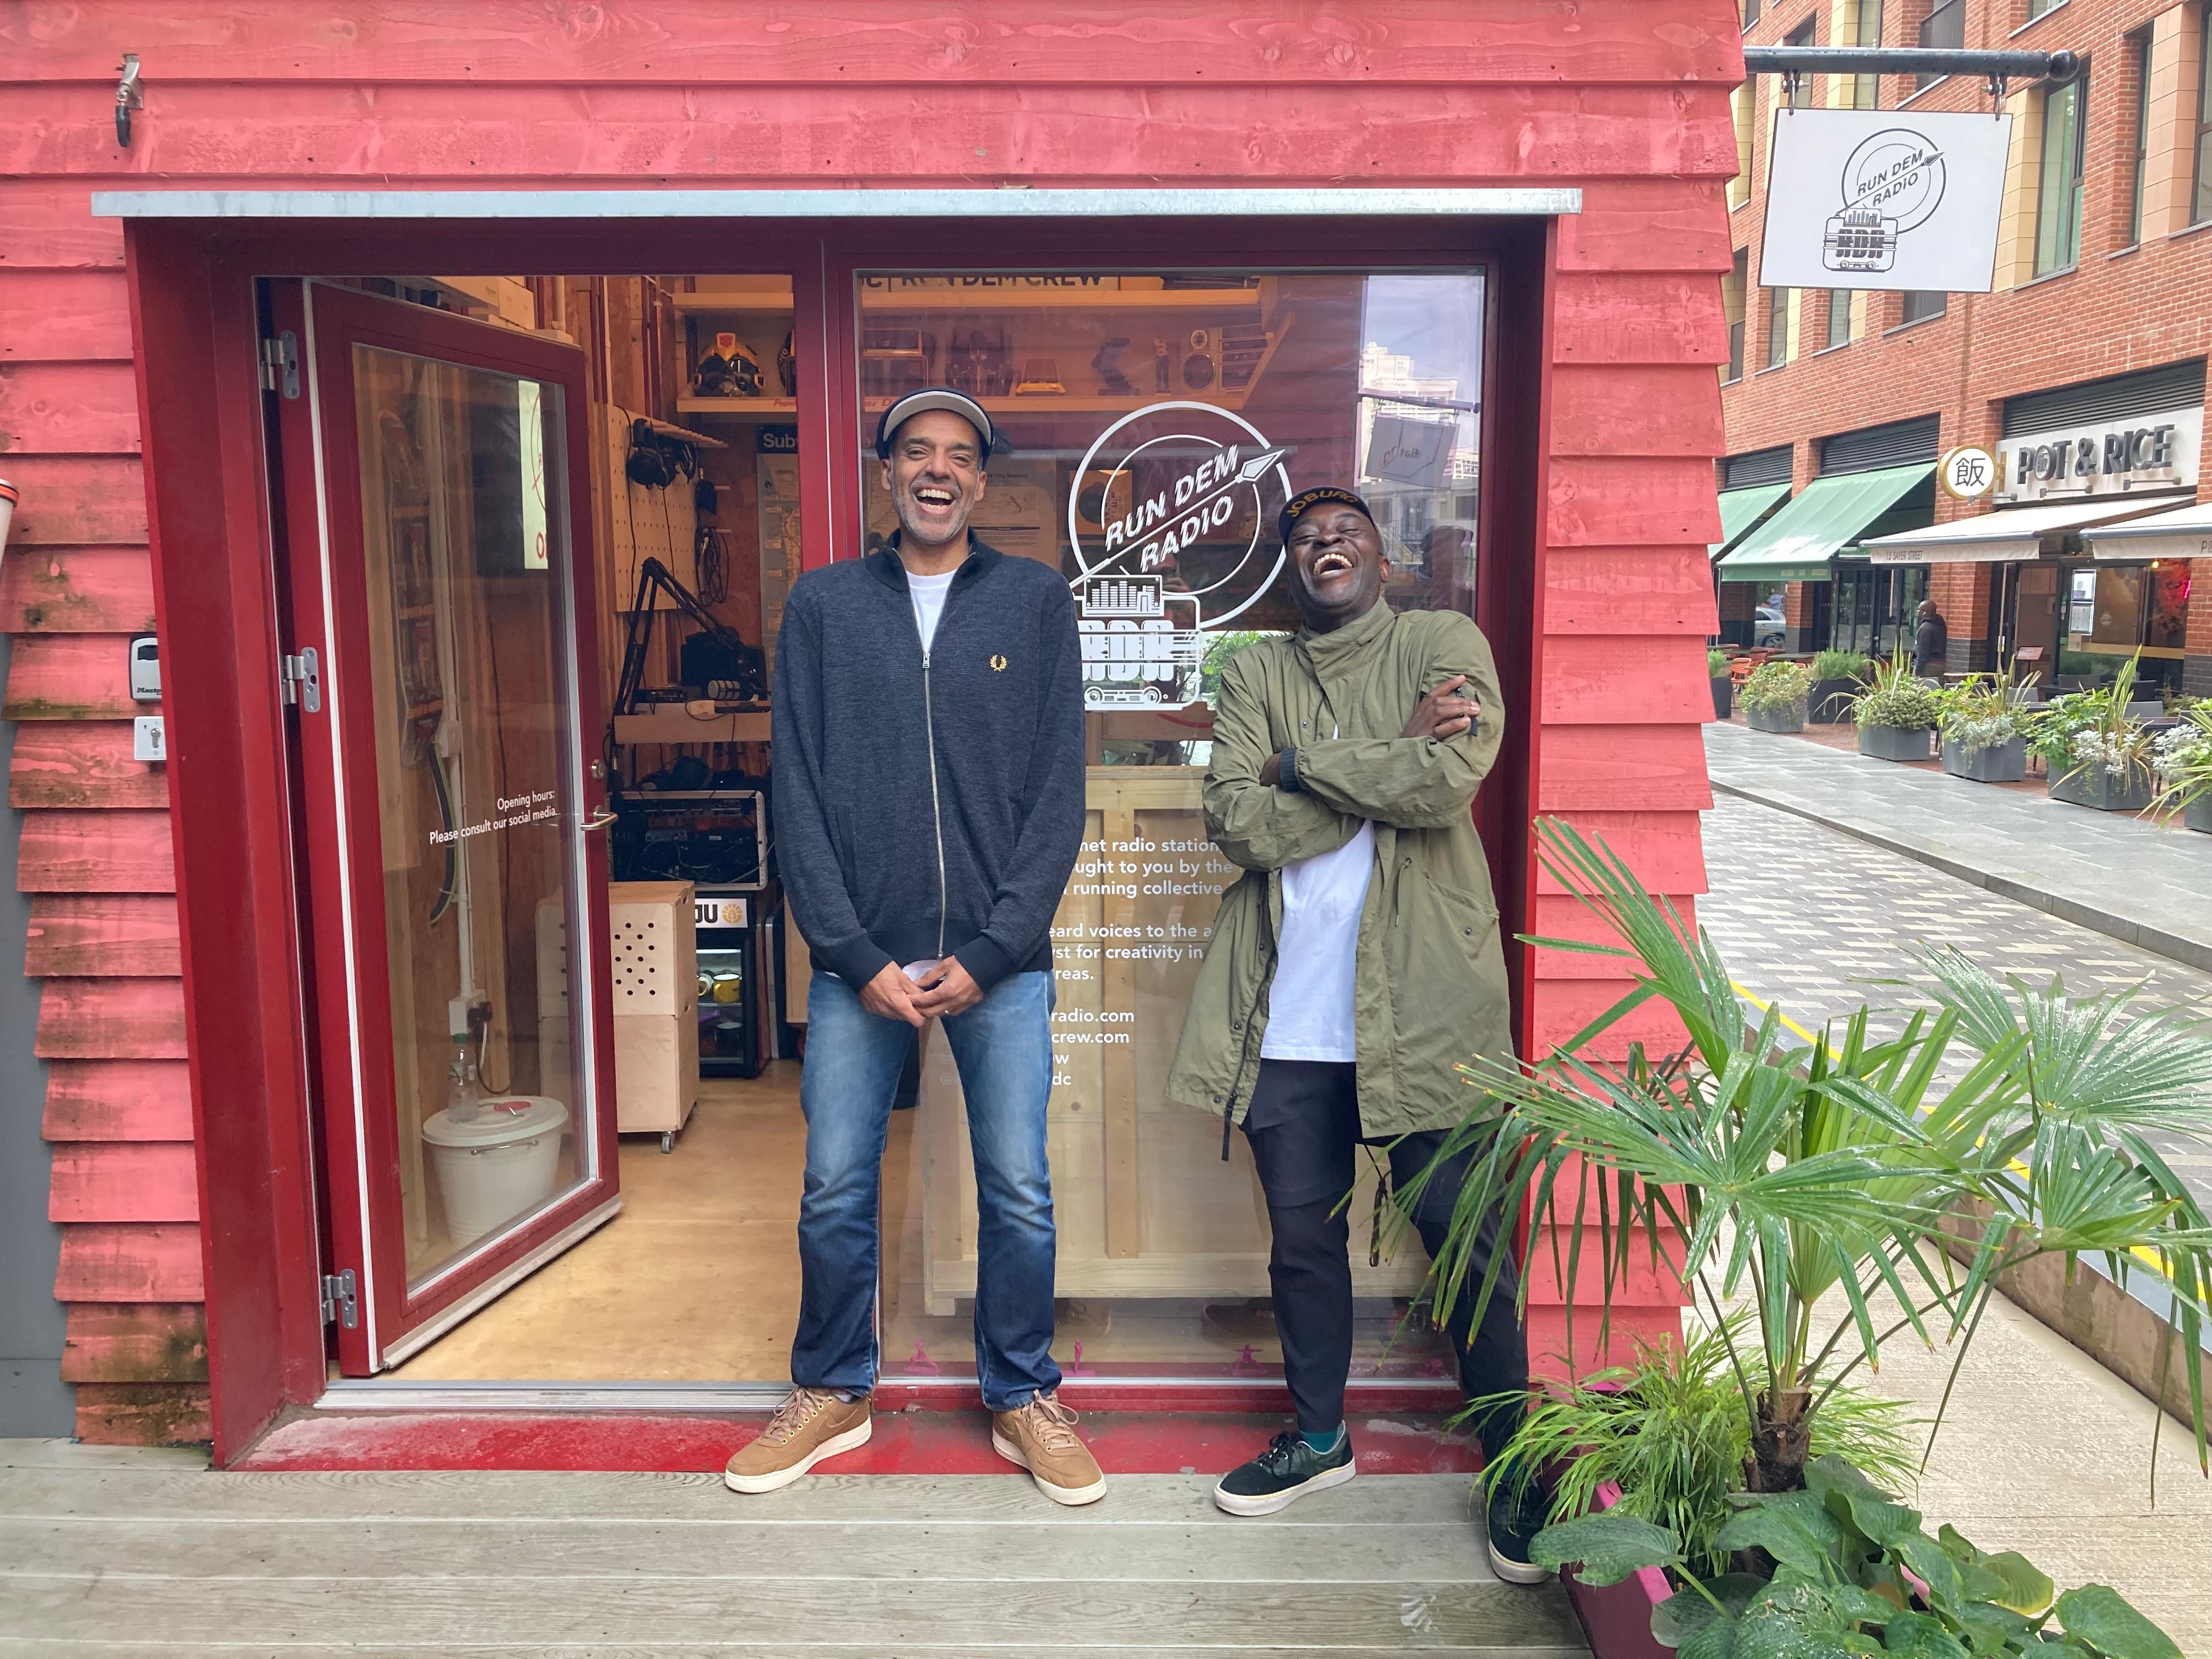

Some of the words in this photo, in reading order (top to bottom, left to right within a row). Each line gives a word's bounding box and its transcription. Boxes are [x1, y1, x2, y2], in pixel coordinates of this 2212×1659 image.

[1857, 170, 1887, 196] RUN
[1892, 149, 1923, 177] DEM
[1873, 173, 1918, 206] RADIO
[763, 433, 798, 448] Sub
[2017, 441, 2072, 484] POT
[2075, 437, 2097, 477] &
[2102, 425, 2175, 475] RICE
[1955, 457, 1986, 487] 飯
[1105, 490, 1166, 551] RUN
[1174, 444, 1239, 507] DEM
[1287, 490, 1358, 517] JOBURG
[1140, 495, 1234, 573] RADIO
[1908, 550, 1923, 560] STREET
[497, 794, 531, 812] Opening
[532, 790, 555, 804] hours:
[430, 829, 459, 845] Please
[461, 819, 491, 838] consult
[493, 819, 507, 830] our
[509, 809, 531, 826] social
[532, 806, 556, 821] media
[1079, 839, 1107, 852] net
[1112, 837, 1156, 852] radio
[1073, 859, 1114, 878] ught
[1119, 860, 1137, 873] to
[1142, 863, 1173, 878] you
[1180, 859, 1200, 878] by
[1205, 859, 1233, 873] the
[1073, 881, 1137, 899] running
[1143, 879, 1223, 895] collective
[1048, 923, 1084, 937] eard
[1088, 923, 1141, 937] voices
[1146, 925, 1164, 937] to
[1170, 923, 1197, 937] the
[1075, 944, 1101, 958] for
[1105, 945, 1183, 963] creativity
[1188, 945, 1203, 958] in
[1054, 969, 1094, 980] reas.
[1051, 1007, 1135, 1023] radio.com
[1051, 1033, 1130, 1043] crew.com
[1052, 1071, 1071, 1085] dc
